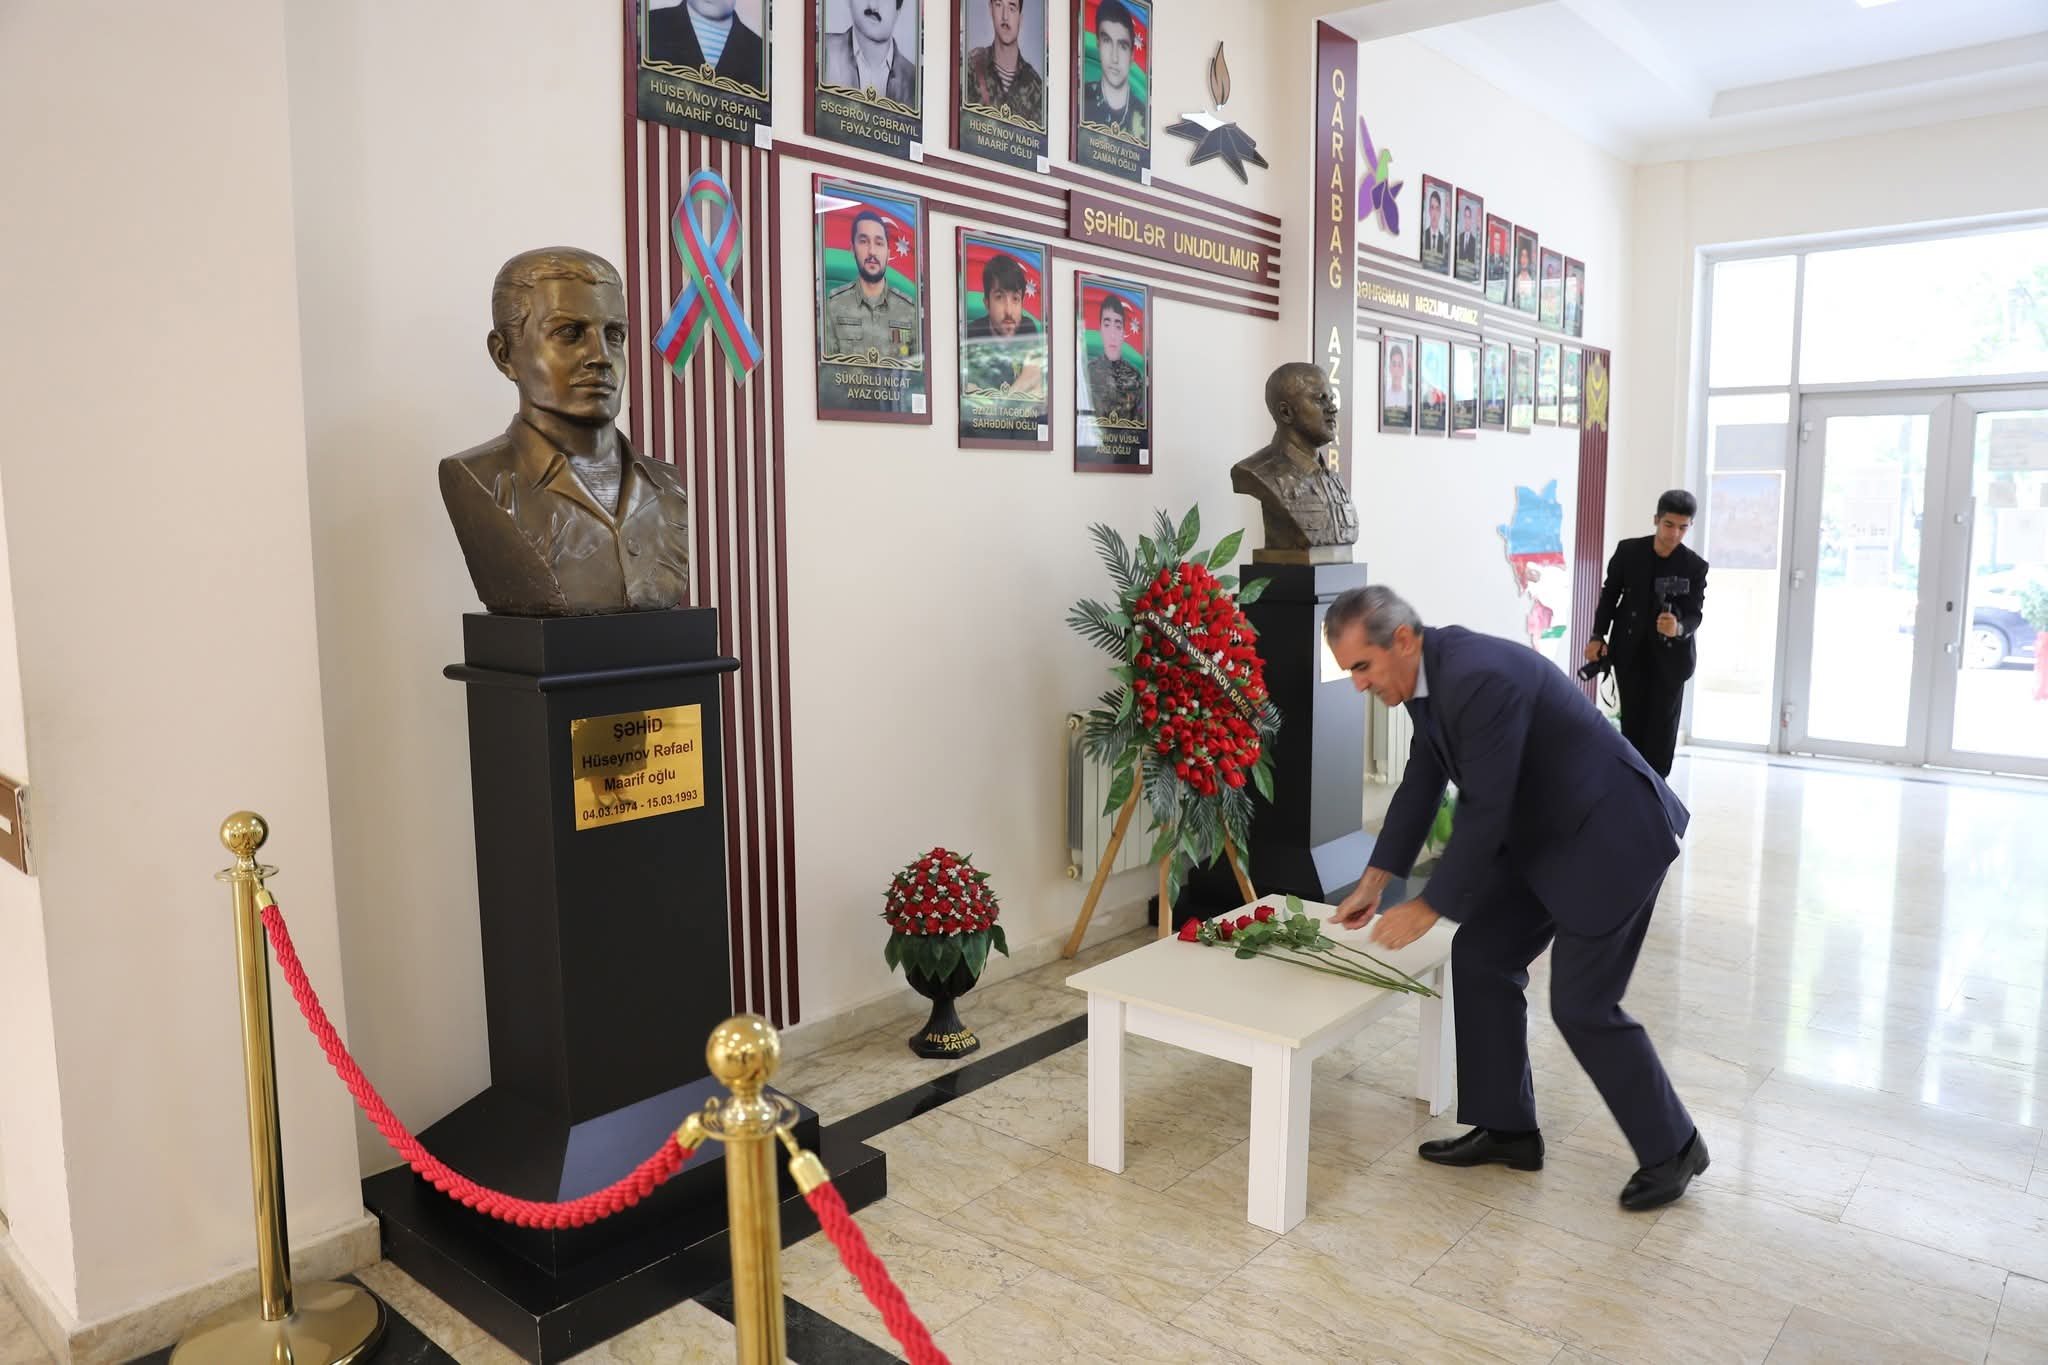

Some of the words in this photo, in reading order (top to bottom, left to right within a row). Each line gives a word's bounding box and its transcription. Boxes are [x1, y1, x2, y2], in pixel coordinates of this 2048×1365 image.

[650, 80, 718, 108] HÜSEYNOV
[721, 99, 762, 120] RƏFAİL
[665, 100, 712, 122] MAARİF
[715, 114, 748, 132] OĞLU
[821, 100, 870, 123] ƏSGƏROV
[872, 114, 919, 137] CƏBRAYIL
[840, 120, 871, 138] FƏYAZ
[873, 129, 901, 146] OĞLU
[978, 135, 1008, 152] MAARİF
[1010, 144, 1033, 160] OĞLU
[1329, 68, 1345, 289] QARABAĞ
[1083, 207, 1166, 249] ŞƏHİDLƏR
[1173, 231, 1259, 272] UNUDULMUR
[847, 388, 872, 400] AYAZ
[873, 387, 901, 401] OĞLU
[972, 418, 1014, 430] SAHƏDDİN
[1015, 419, 1038, 431] OĞLU
[613, 715, 663, 741] ŞƏHİD
[582, 748, 650, 769] Hüseynov
[653, 739, 694, 758] Rəfael
[604, 771, 646, 792] Maarif
[648, 767, 676, 785] oğlu
[582, 801, 638, 821] 04.03.1974
[647, 789, 698, 809] 15.03.1993
